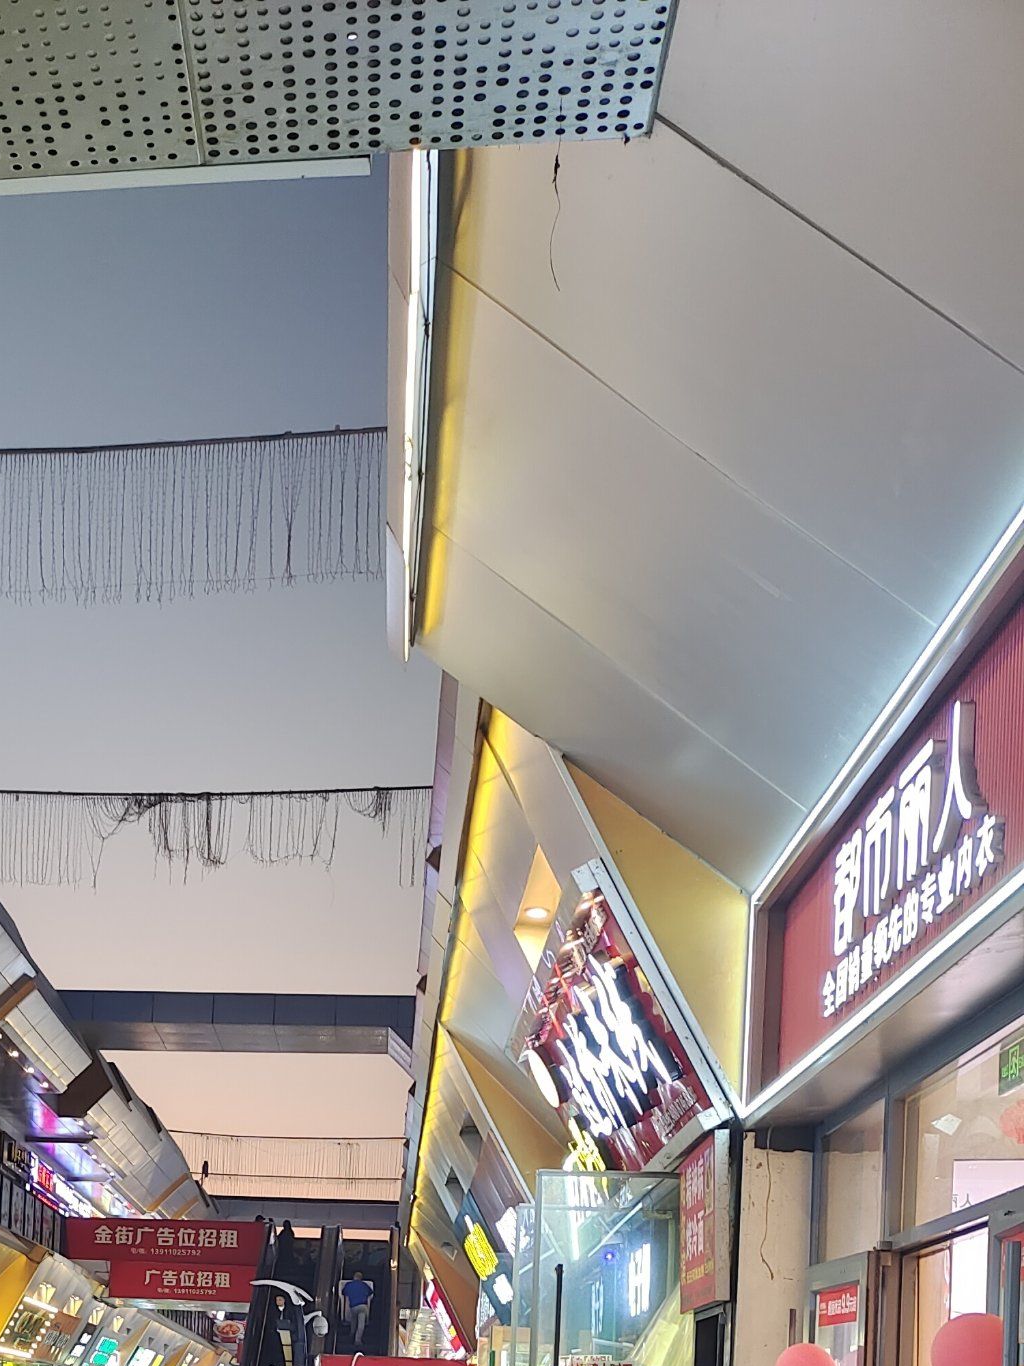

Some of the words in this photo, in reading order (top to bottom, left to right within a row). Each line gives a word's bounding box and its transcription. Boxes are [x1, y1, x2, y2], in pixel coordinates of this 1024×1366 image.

[833, 700, 973, 957] 都市丽人
[822, 815, 997, 1019] 全国销量领先的专业内衣
[93, 1225, 238, 1248] 金街广告位招租
[150, 1248, 201, 1256] 13911025792
[144, 1269, 231, 1288] 广告位招租
